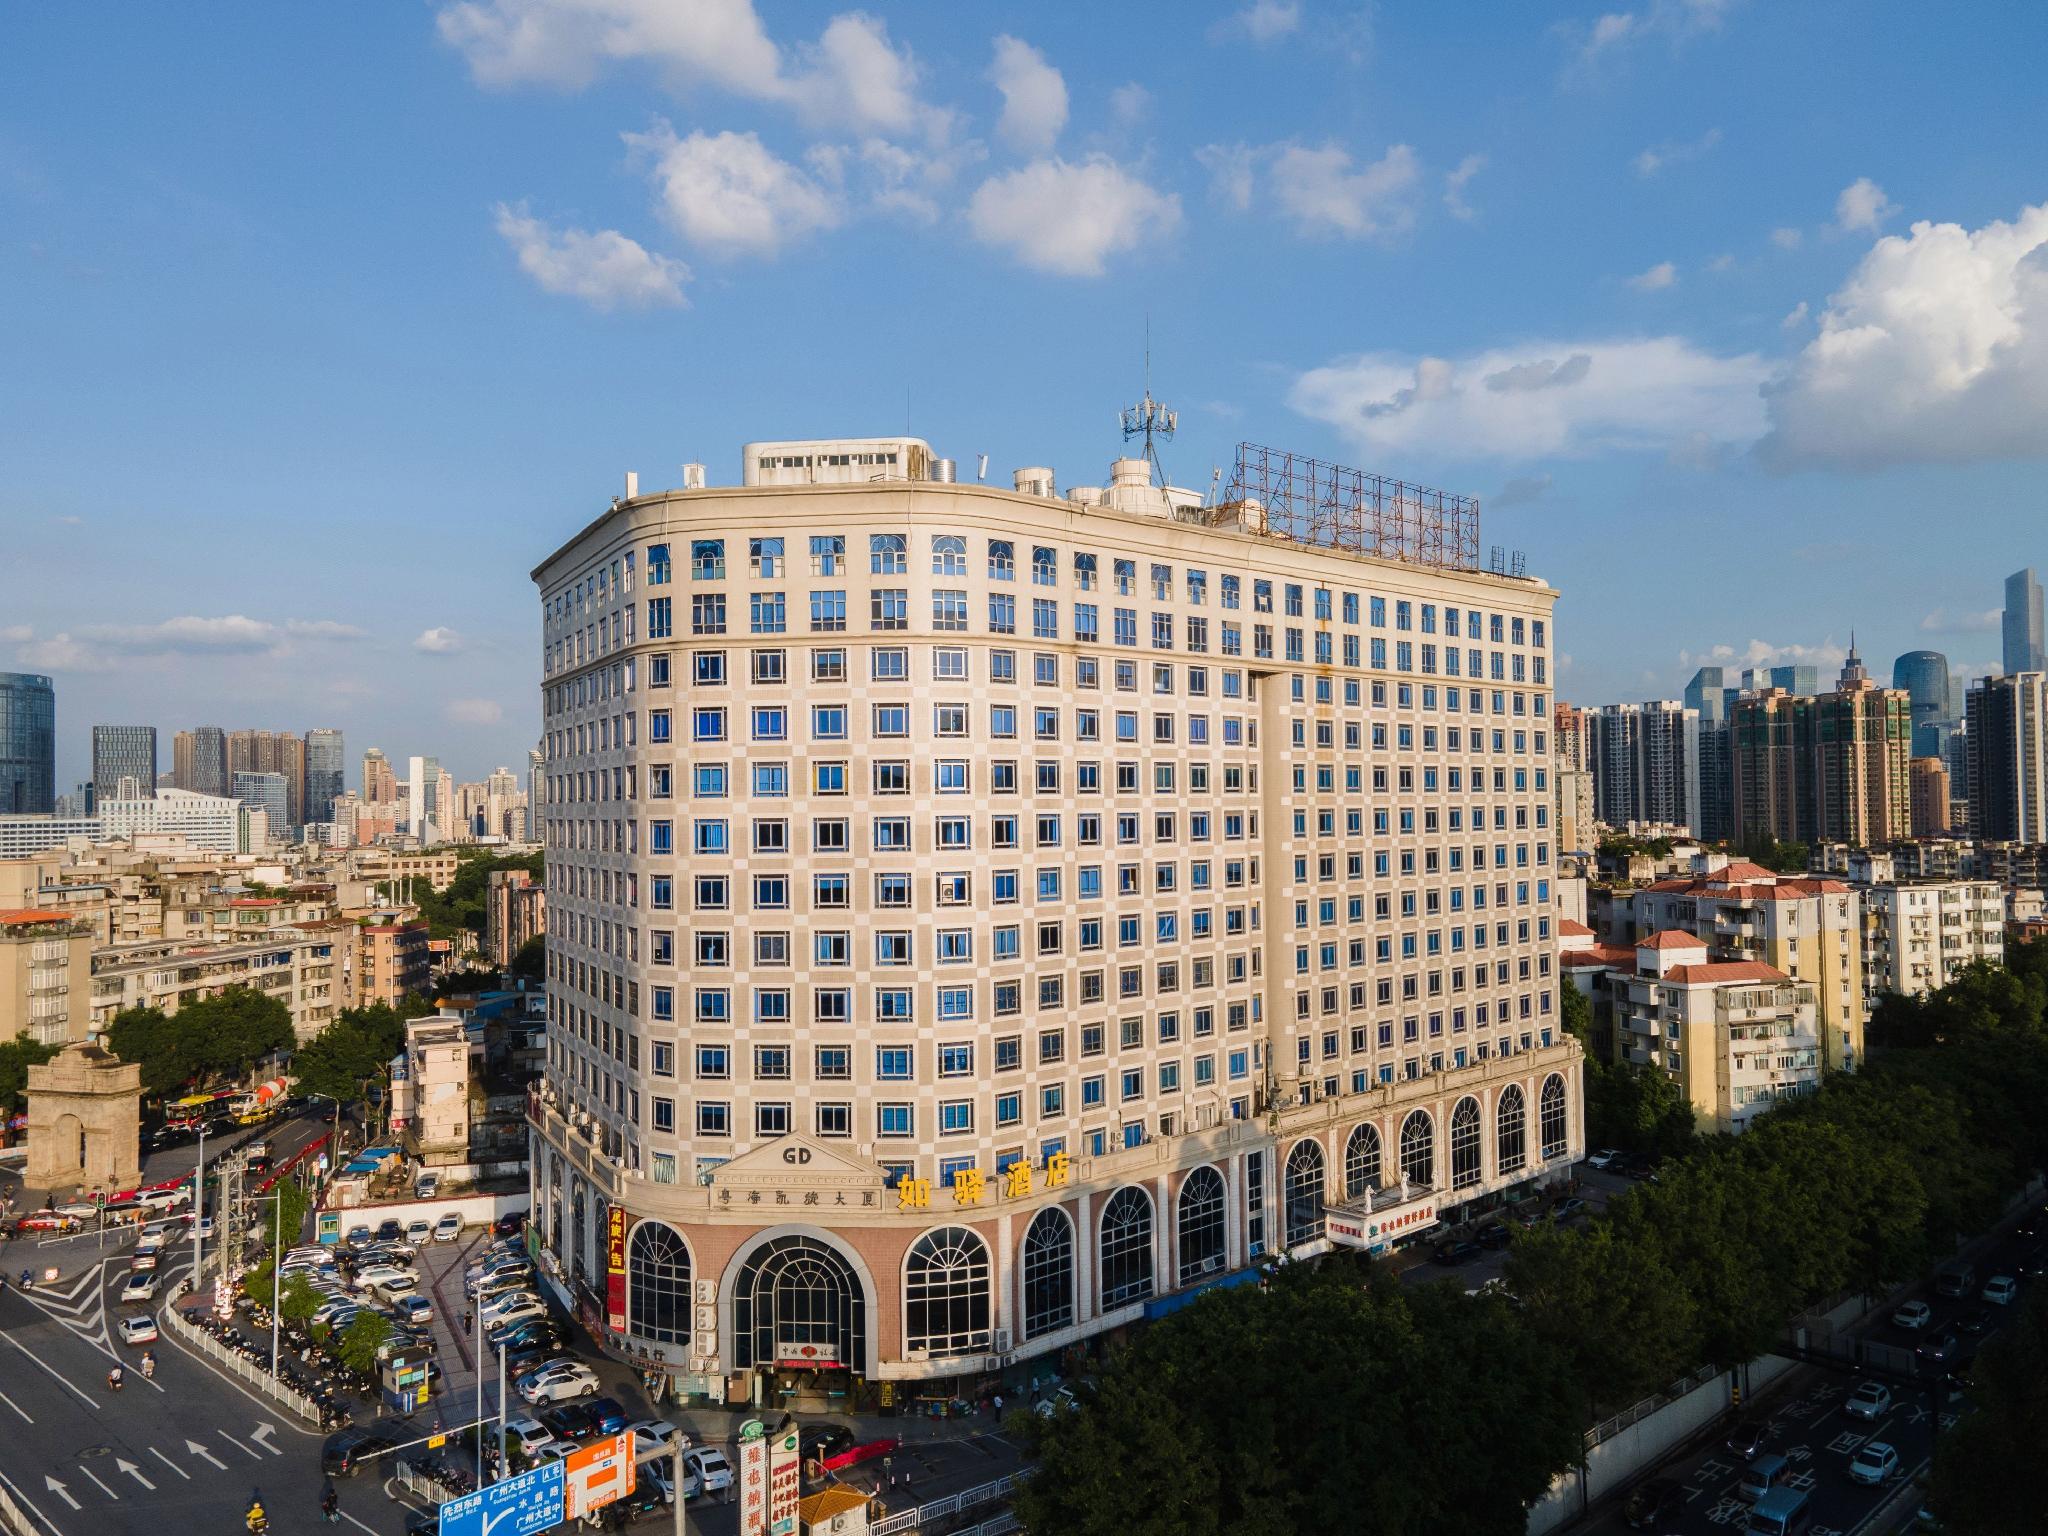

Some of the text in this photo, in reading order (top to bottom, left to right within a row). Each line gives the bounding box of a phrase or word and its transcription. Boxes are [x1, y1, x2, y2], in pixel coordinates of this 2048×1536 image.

[782, 1147, 812, 1165] GD
[896, 1150, 1071, 1211] 如驿酒店
[490, 1475, 536, 1501] 广州大道北
[747, 1446, 762, 1536] 维也纳酒
[444, 1495, 482, 1518] 先烈东路
[516, 1502, 561, 1528] 广州大道中
